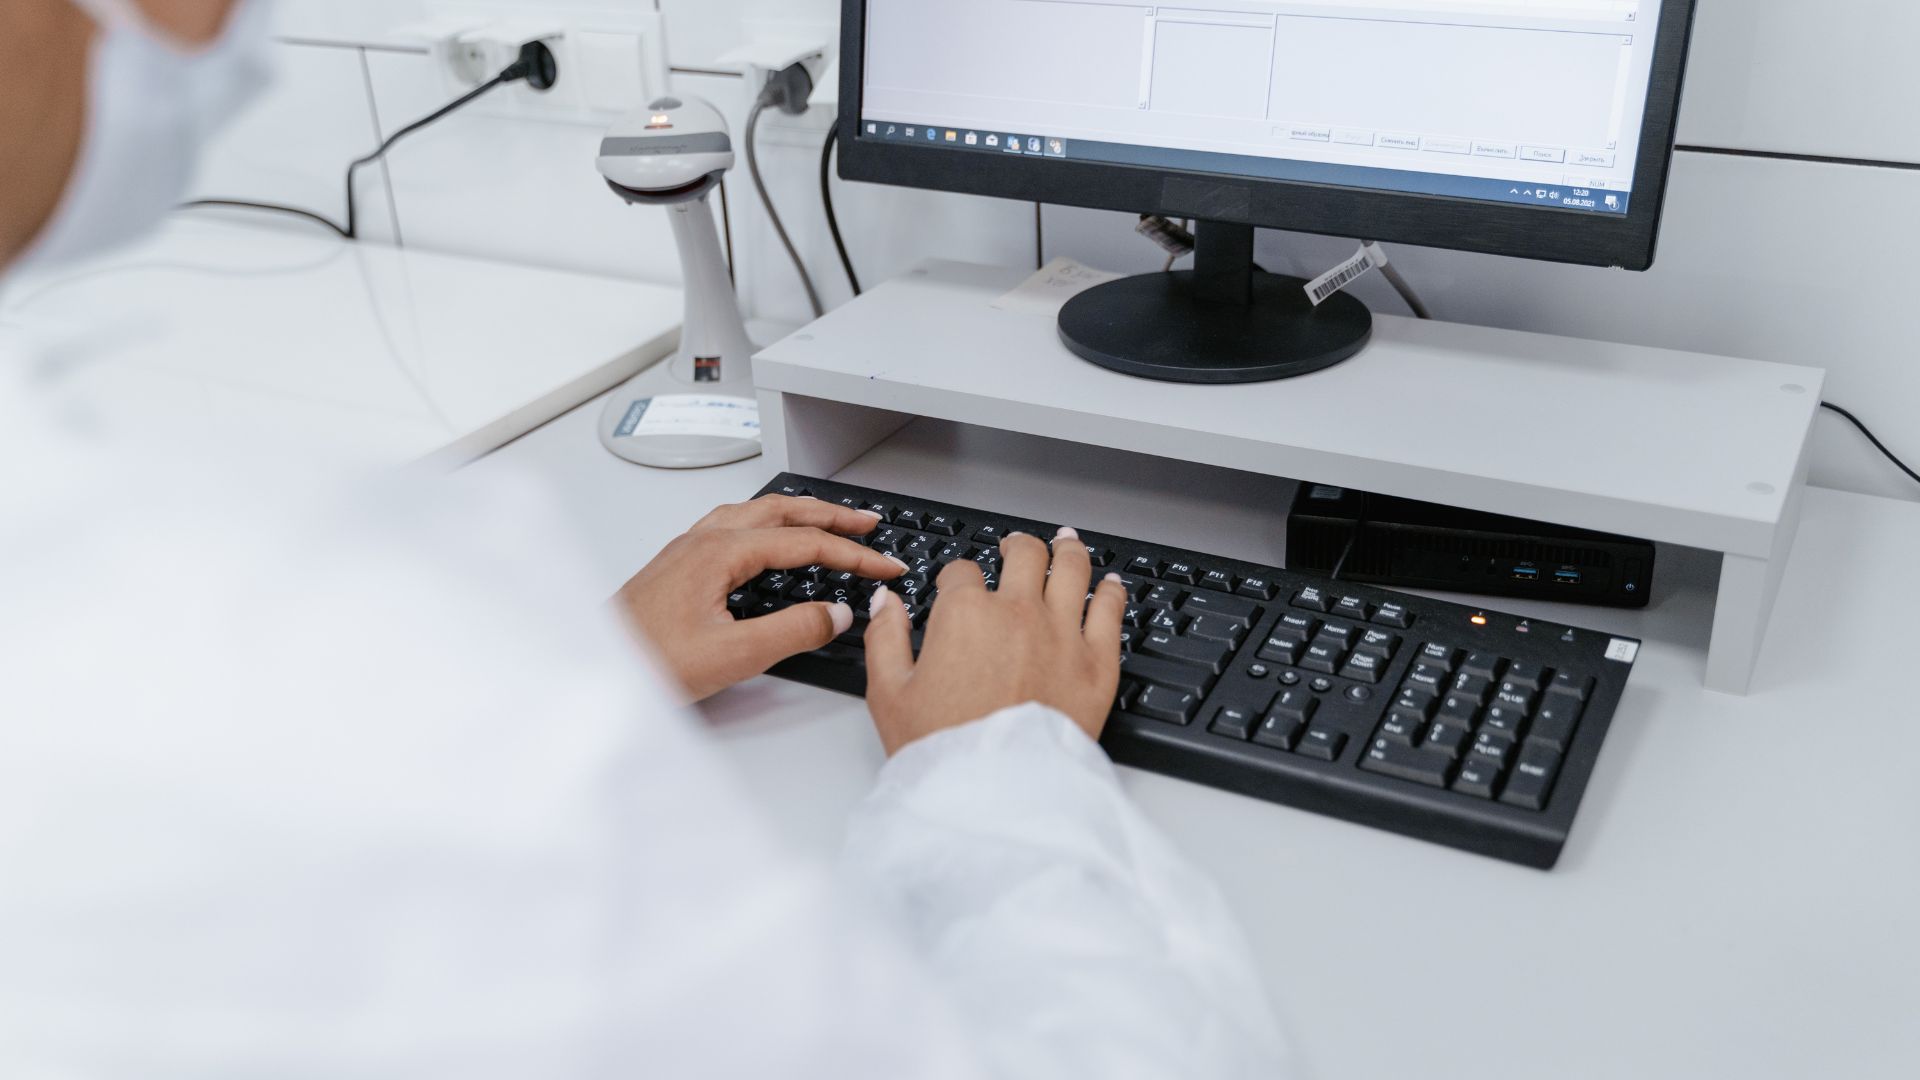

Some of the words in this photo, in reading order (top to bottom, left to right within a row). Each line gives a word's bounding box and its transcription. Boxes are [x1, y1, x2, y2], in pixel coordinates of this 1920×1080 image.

[1573, 189, 1589, 197] 12:20
[1563, 198, 1595, 207] 05.08.2021
[916, 557, 926, 565] T
[1172, 563, 1188, 572] F10
[770, 574, 782, 582] Z
[1209, 571, 1225, 579] F11
[1246, 578, 1263, 587] F12
[1383, 602, 1401, 610] Pause
[1284, 615, 1307, 626] Insert
[1324, 623, 1347, 635] Home
[1365, 635, 1376, 644] Up
[1367, 630, 1387, 640] Page
[1269, 638, 1293, 649] Delete
[1427, 643, 1446, 652] Num
[1310, 646, 1327, 656] End
[1425, 648, 1443, 657] Lock
[1353, 653, 1374, 663] Page
[1351, 658, 1373, 669] Down
[1411, 672, 1436, 684] Home
